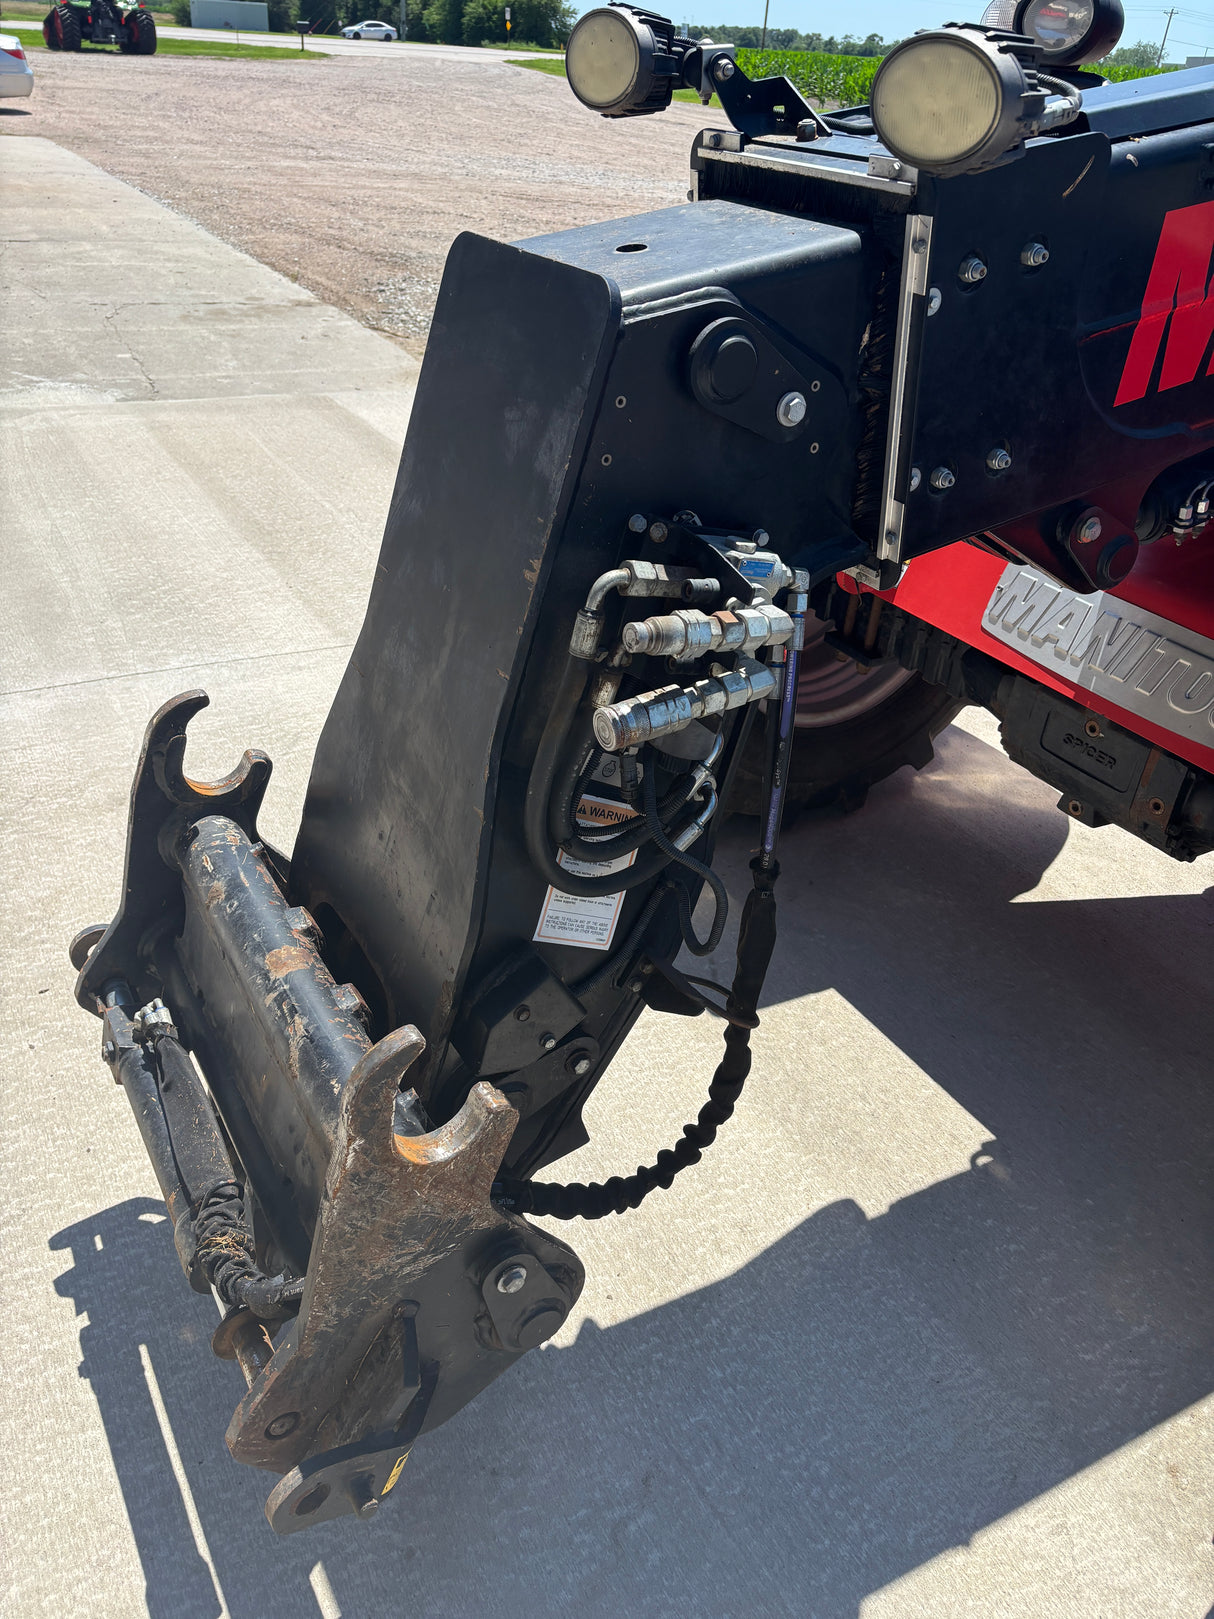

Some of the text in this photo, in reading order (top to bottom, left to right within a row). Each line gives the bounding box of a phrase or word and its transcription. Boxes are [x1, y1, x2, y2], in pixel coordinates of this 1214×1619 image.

[988, 571, 1214, 728] MANITO
[1062, 732, 1117, 770] SPICER
[589, 806, 634, 823] WARNIN
